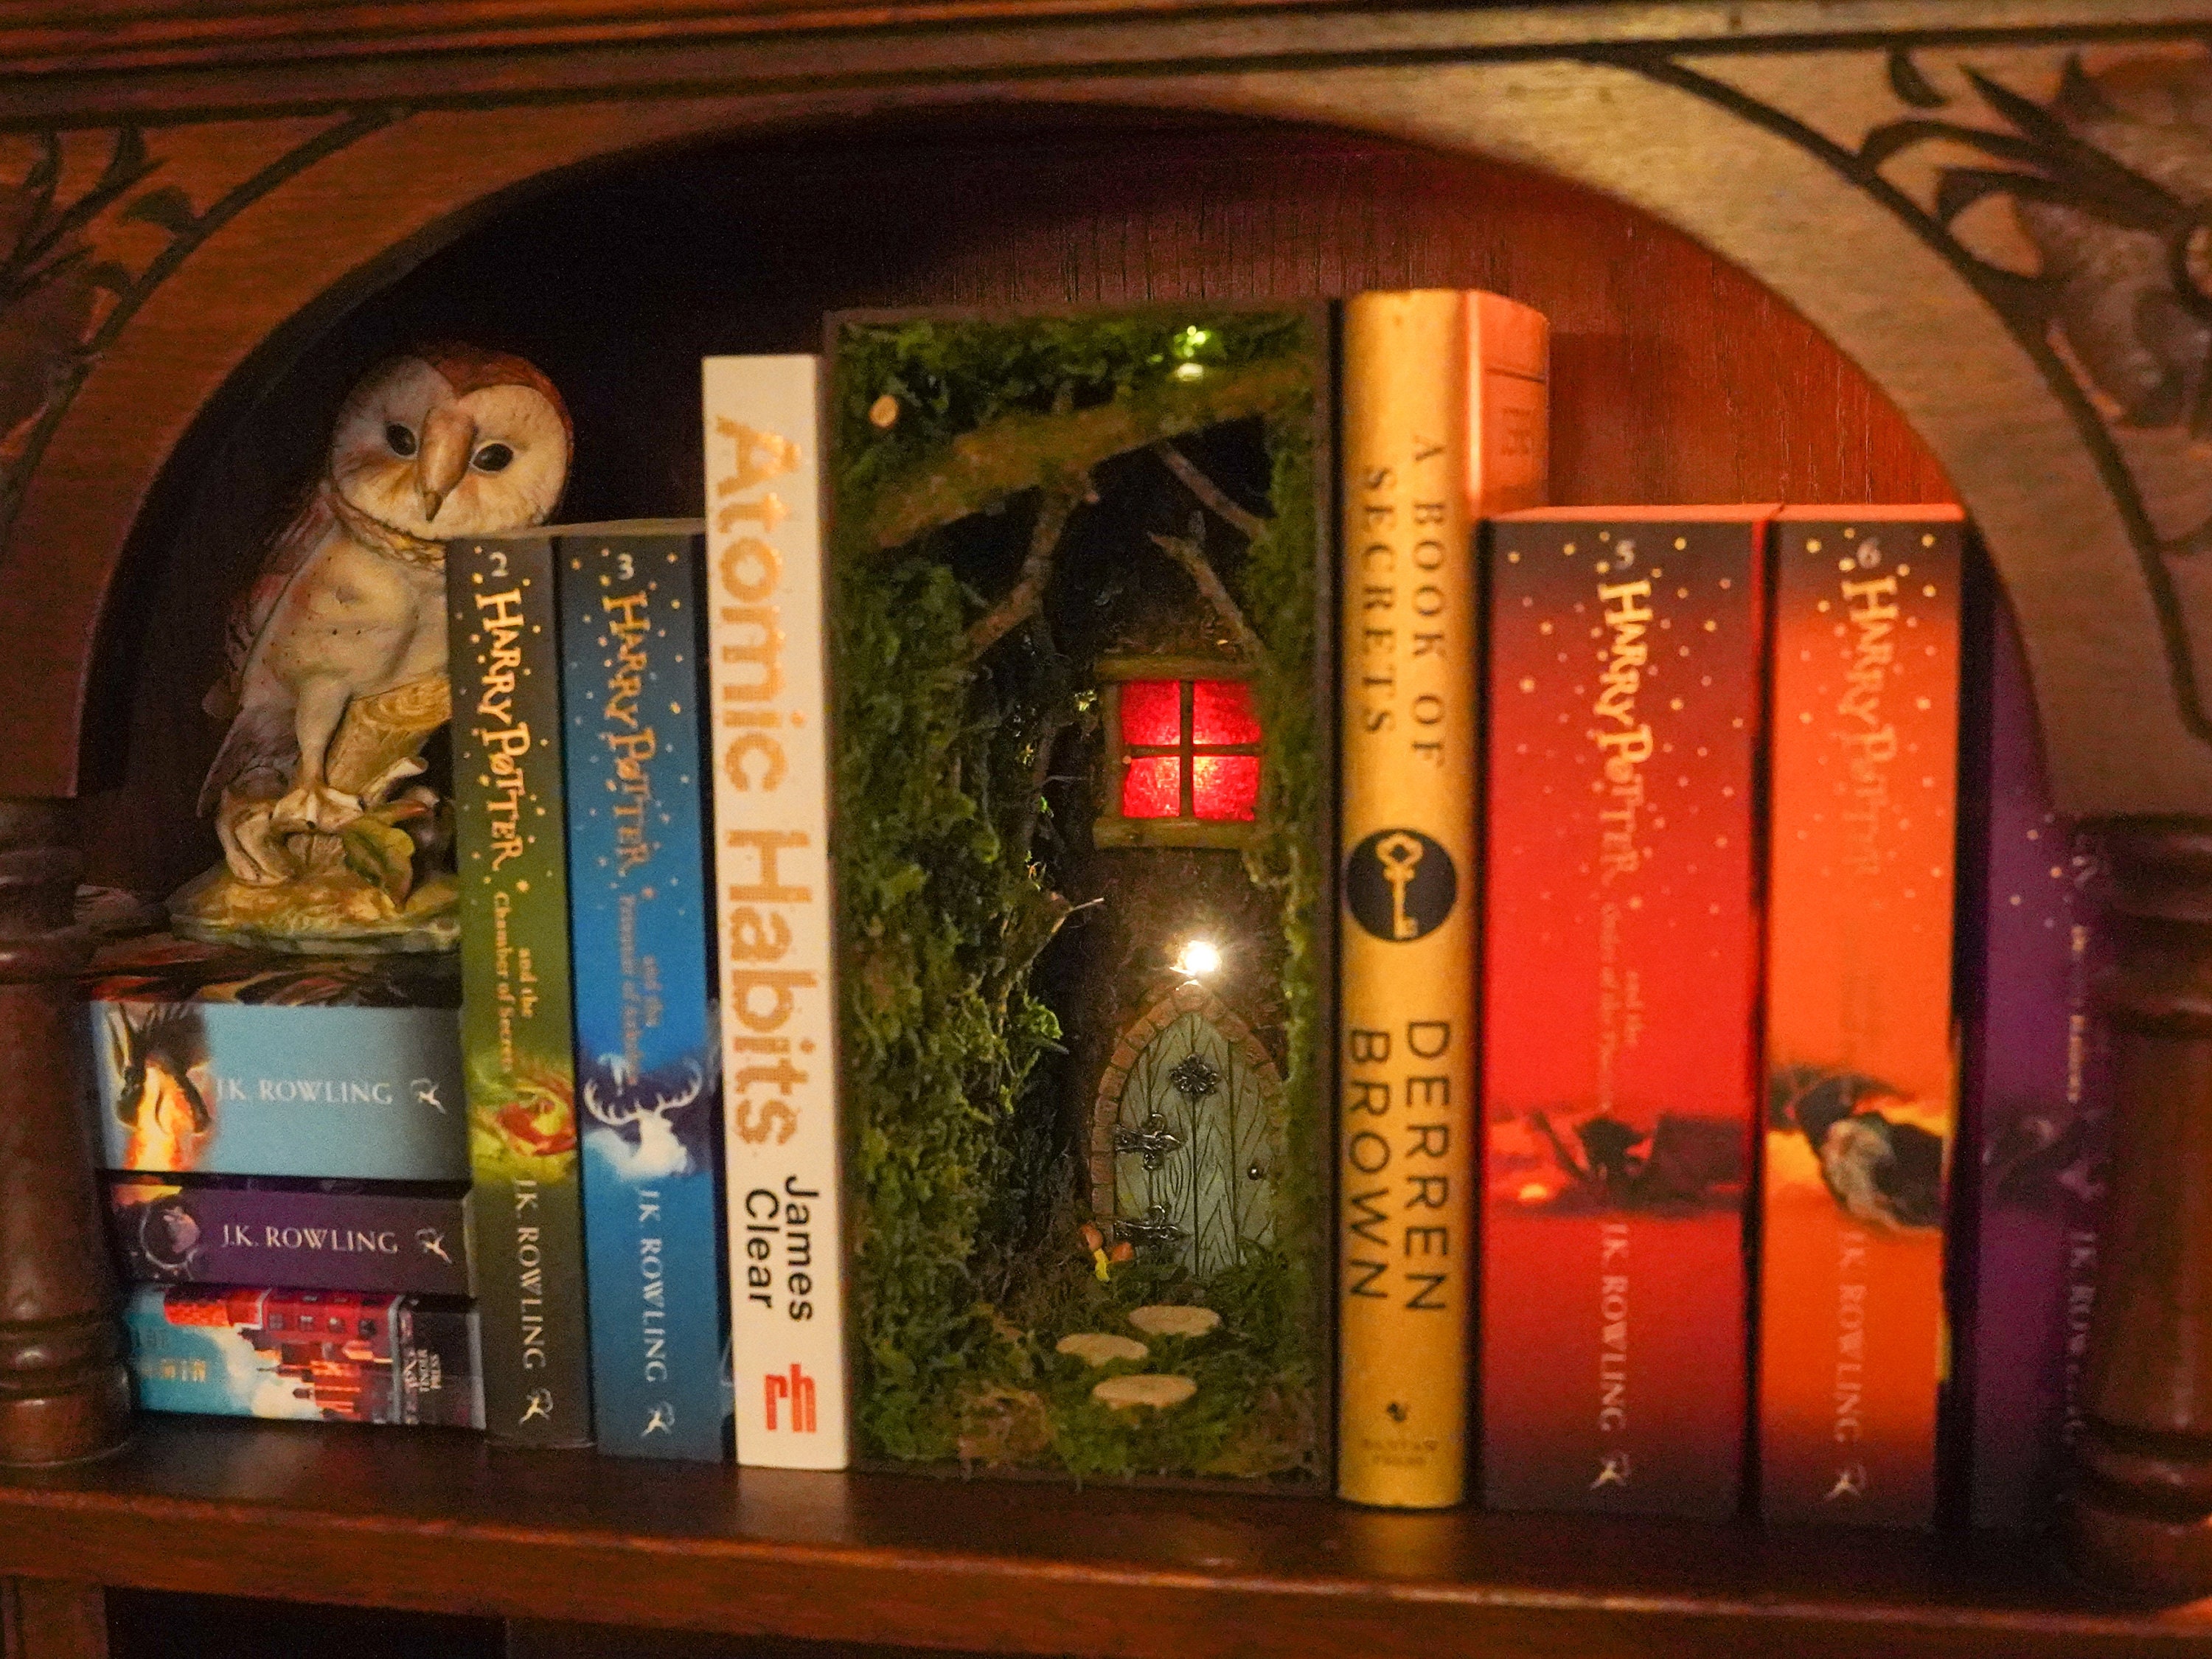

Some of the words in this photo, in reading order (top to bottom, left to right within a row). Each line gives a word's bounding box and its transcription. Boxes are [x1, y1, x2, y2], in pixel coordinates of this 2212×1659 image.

[488, 551, 509, 577] 2
[617, 552, 636, 581] 3
[716, 415, 808, 792] Atomic
[476, 588, 524, 726] HARRY
[602, 589, 651, 729] HARRY
[1593, 579, 1654, 726] HARRY
[481, 722, 531, 872] POTTER
[725, 829, 818, 1145] Habits
[259, 1079, 394, 1105] ROWLING
[1349, 1029, 1392, 1299] BROWN
[1405, 1020, 1450, 1310] DERREN
[265, 1225, 400, 1255] ROWLING
[516, 1226, 547, 1370] ROWLING
[641, 1237, 669, 1383] ROWLING
[745, 1189, 780, 1310] Clear
[785, 1175, 820, 1322] James
[1600, 1276, 1629, 1432] ROWLING
[1834, 1284, 1868, 1443] ROWLING
